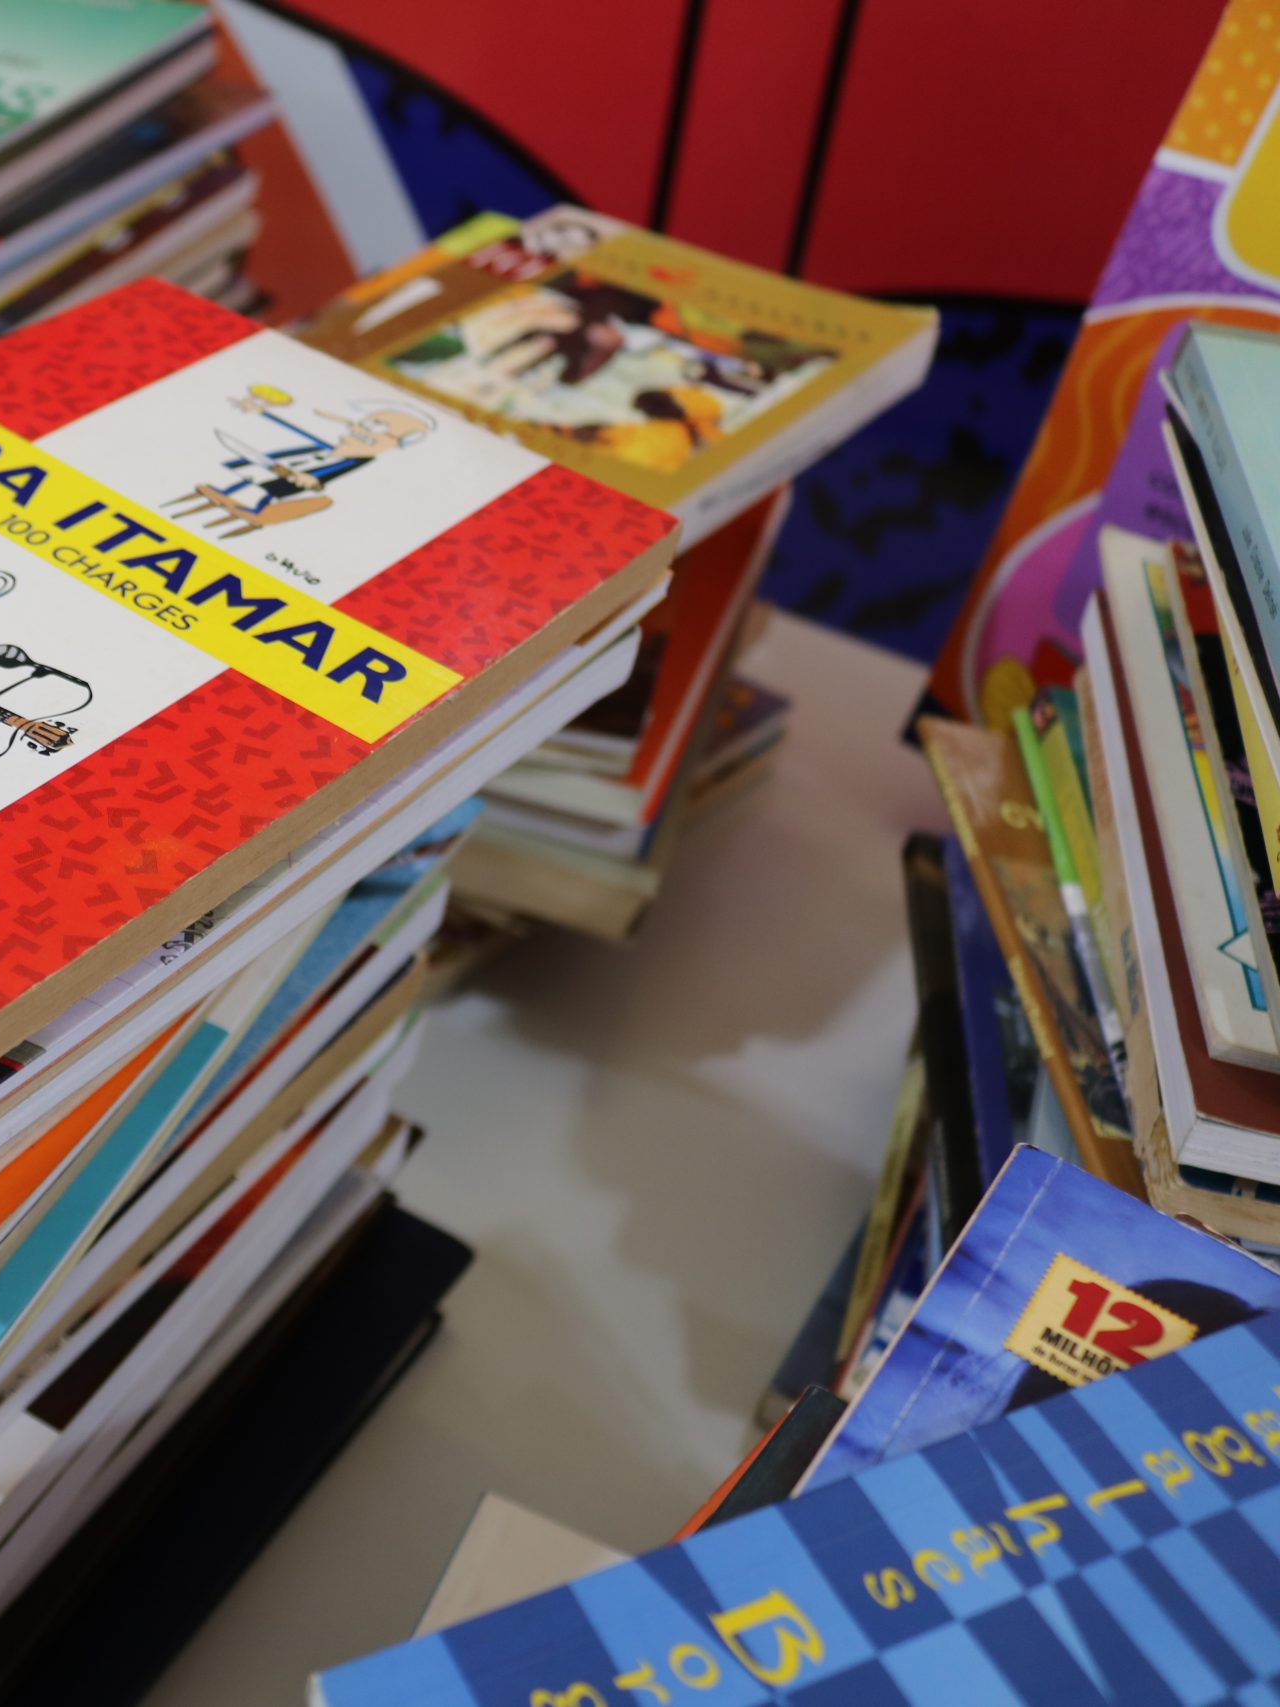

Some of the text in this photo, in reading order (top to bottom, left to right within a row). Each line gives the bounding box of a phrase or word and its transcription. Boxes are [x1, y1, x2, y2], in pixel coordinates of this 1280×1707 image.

[51, 544, 199, 632] CHARGES
[54, 500, 408, 704] ITAMAR
[1039, 1326, 1124, 1375] MILHÕ
[1061, 1279, 1165, 1365] 12
[861, 1384, 1280, 1612] agalhães
